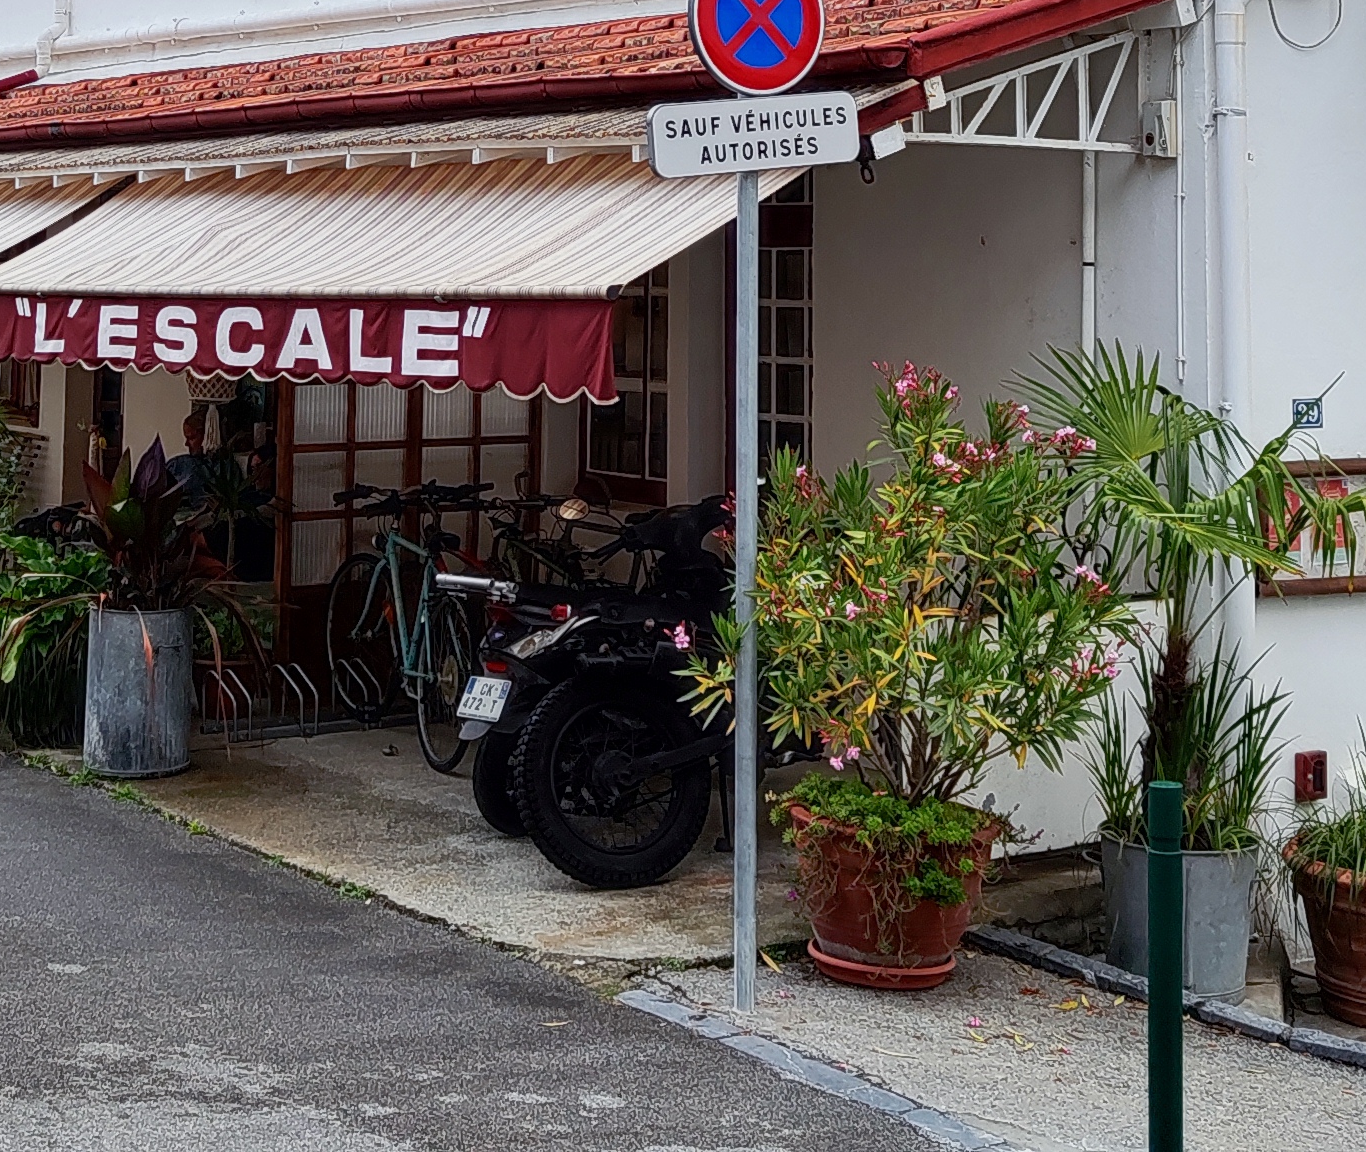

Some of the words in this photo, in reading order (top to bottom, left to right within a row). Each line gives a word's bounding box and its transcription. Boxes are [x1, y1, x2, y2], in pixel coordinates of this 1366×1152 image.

[665, 116, 721, 139] SAUF
[730, 106, 847, 134] VÉHICULES
[700, 133, 819, 164] AUTORISÉS
